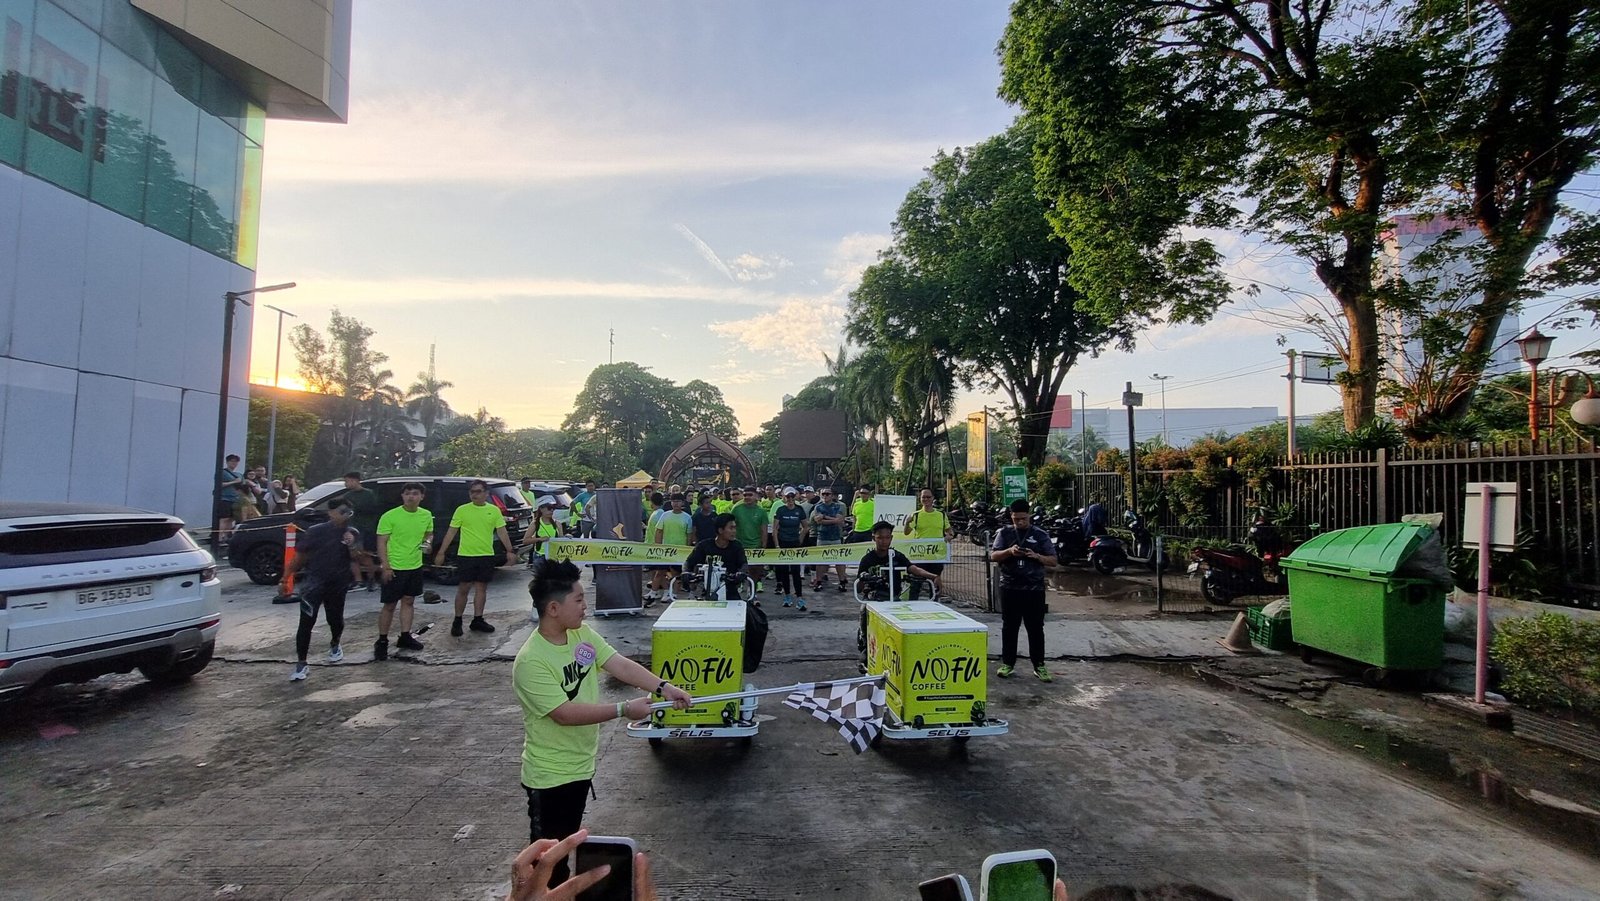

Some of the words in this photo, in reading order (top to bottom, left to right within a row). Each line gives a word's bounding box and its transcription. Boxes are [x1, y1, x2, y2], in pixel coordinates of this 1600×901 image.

[556, 545, 589, 556] NOFU
[601, 546, 633, 556] NOFU
[646, 547, 678, 557] NOFU
[744, 549, 766, 558] OFU
[778, 549, 809, 558] NOFU
[821, 548, 853, 558] NOFU
[909, 544, 939, 554] NOFU
[42, 568, 111, 579] RANGE
[124, 562, 179, 571] ROVER
[79, 593, 97, 604] BG
[659, 657, 735, 685] NOFU
[910, 657, 982, 684] NOFU
[912, 683, 946, 691] COFFEE
[668, 729, 714, 738] SELIS
[927, 729, 971, 737] SELIS
